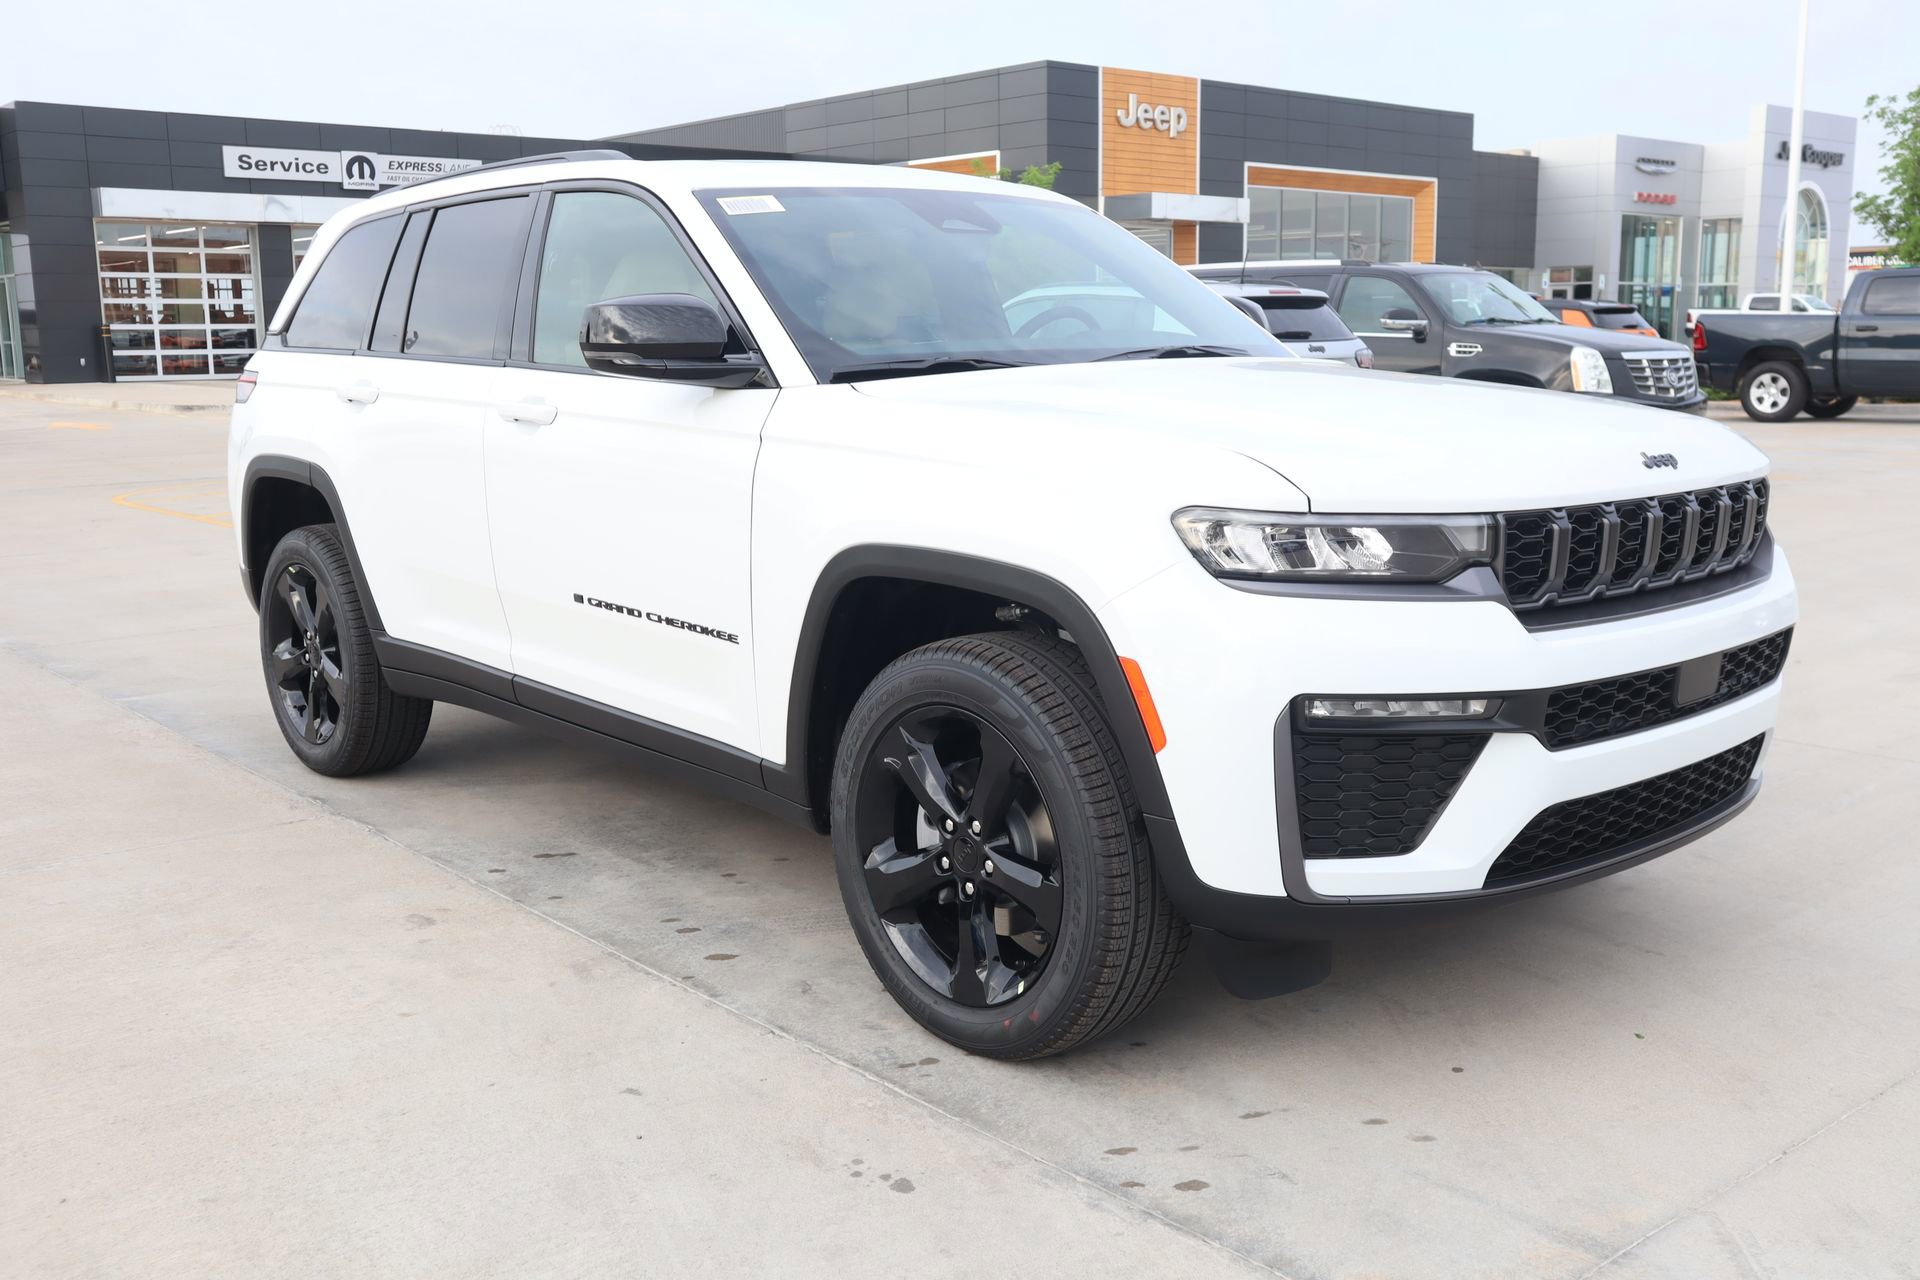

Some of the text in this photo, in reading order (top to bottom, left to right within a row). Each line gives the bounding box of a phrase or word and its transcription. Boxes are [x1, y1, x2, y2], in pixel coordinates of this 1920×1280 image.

[1116, 93, 1187, 138] Jeep
[237, 154, 329, 175] Service
[1640, 451, 1678, 470] Jeep
[587, 597, 739, 645] GRAND CHEROKEE
